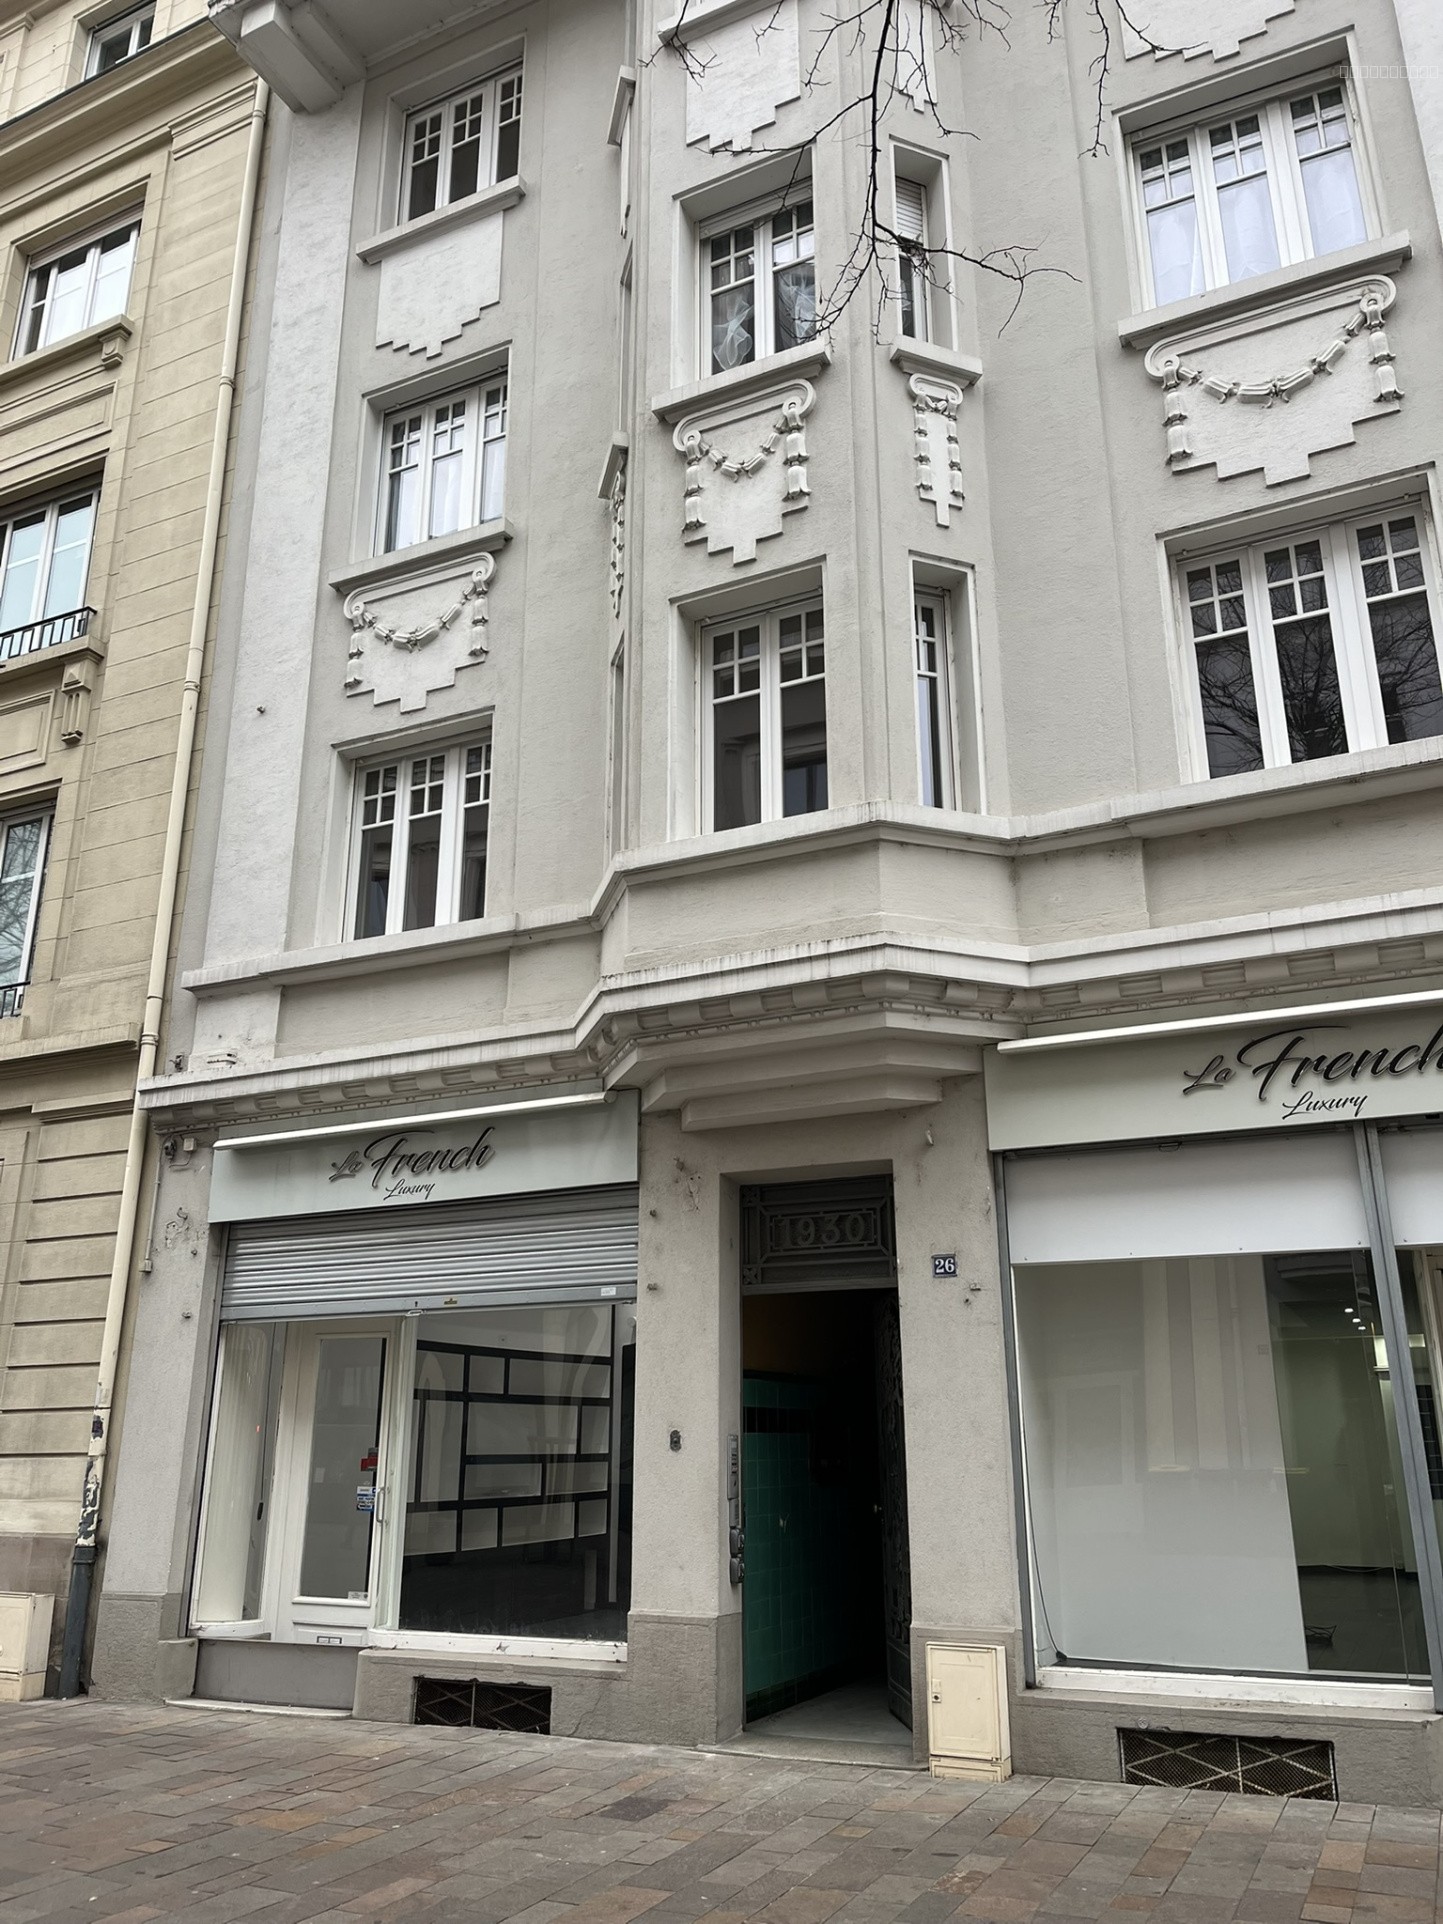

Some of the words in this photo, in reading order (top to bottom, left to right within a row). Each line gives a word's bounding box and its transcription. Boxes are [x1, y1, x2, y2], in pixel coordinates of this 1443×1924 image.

[1182, 1054, 1236, 1096] La
[1281, 1091, 1368, 1120] Luxury
[363, 1126, 496, 1189] French
[383, 1178, 436, 1201] Luxury
[777, 1212, 866, 1247] 1930
[935, 1257, 955, 1273] 26
